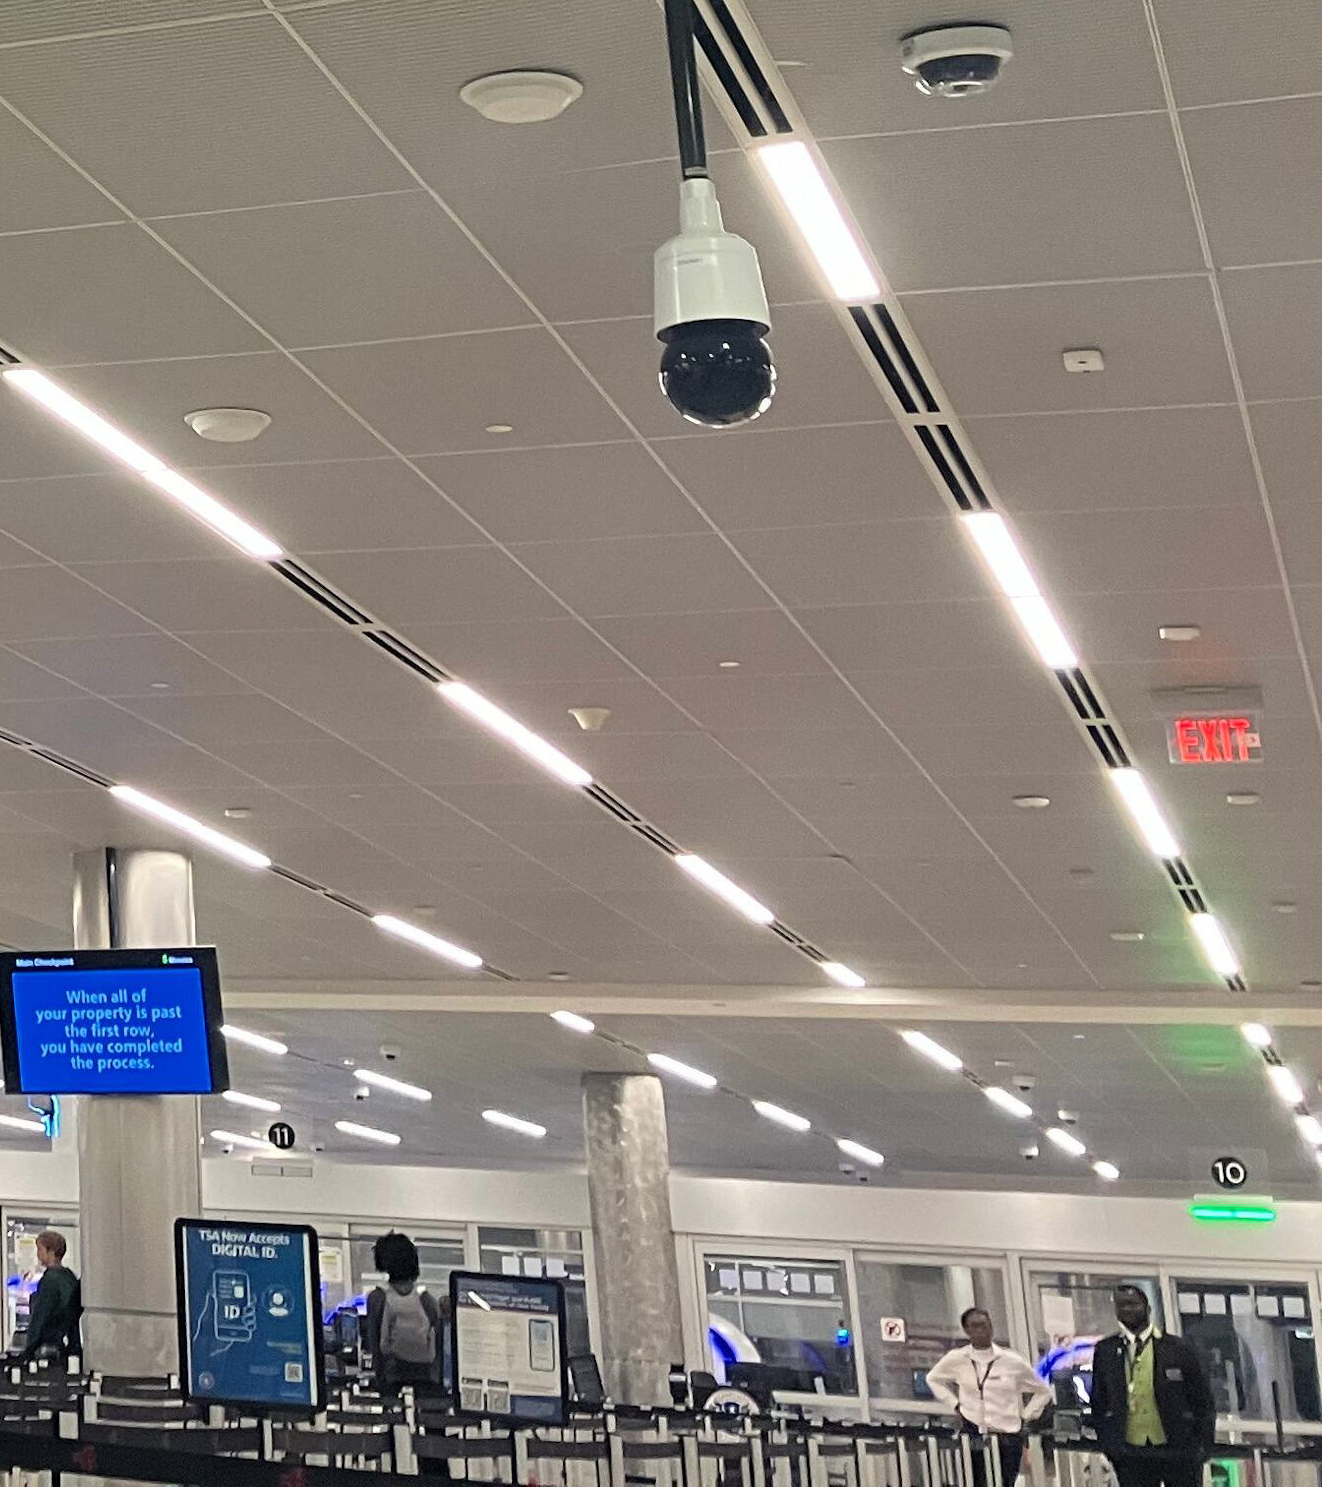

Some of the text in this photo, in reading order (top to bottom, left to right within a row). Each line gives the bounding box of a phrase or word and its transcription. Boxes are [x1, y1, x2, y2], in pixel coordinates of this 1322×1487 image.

[1175, 719, 1250, 762] EXIT
[66, 988, 147, 1004] When all of
[35, 1005, 182, 1024] your property is past
[65, 1023, 155, 1038] the first row,
[40, 1038, 183, 1057] you have completed
[70, 1056, 155, 1073] the process.
[273, 1127, 289, 1146] 11
[1214, 1160, 1245, 1184] 10
[198, 1230, 290, 1246] TSA Now Accepts
[212, 1243, 260, 1258] DIGITAL
[224, 1305, 241, 1319] ID
